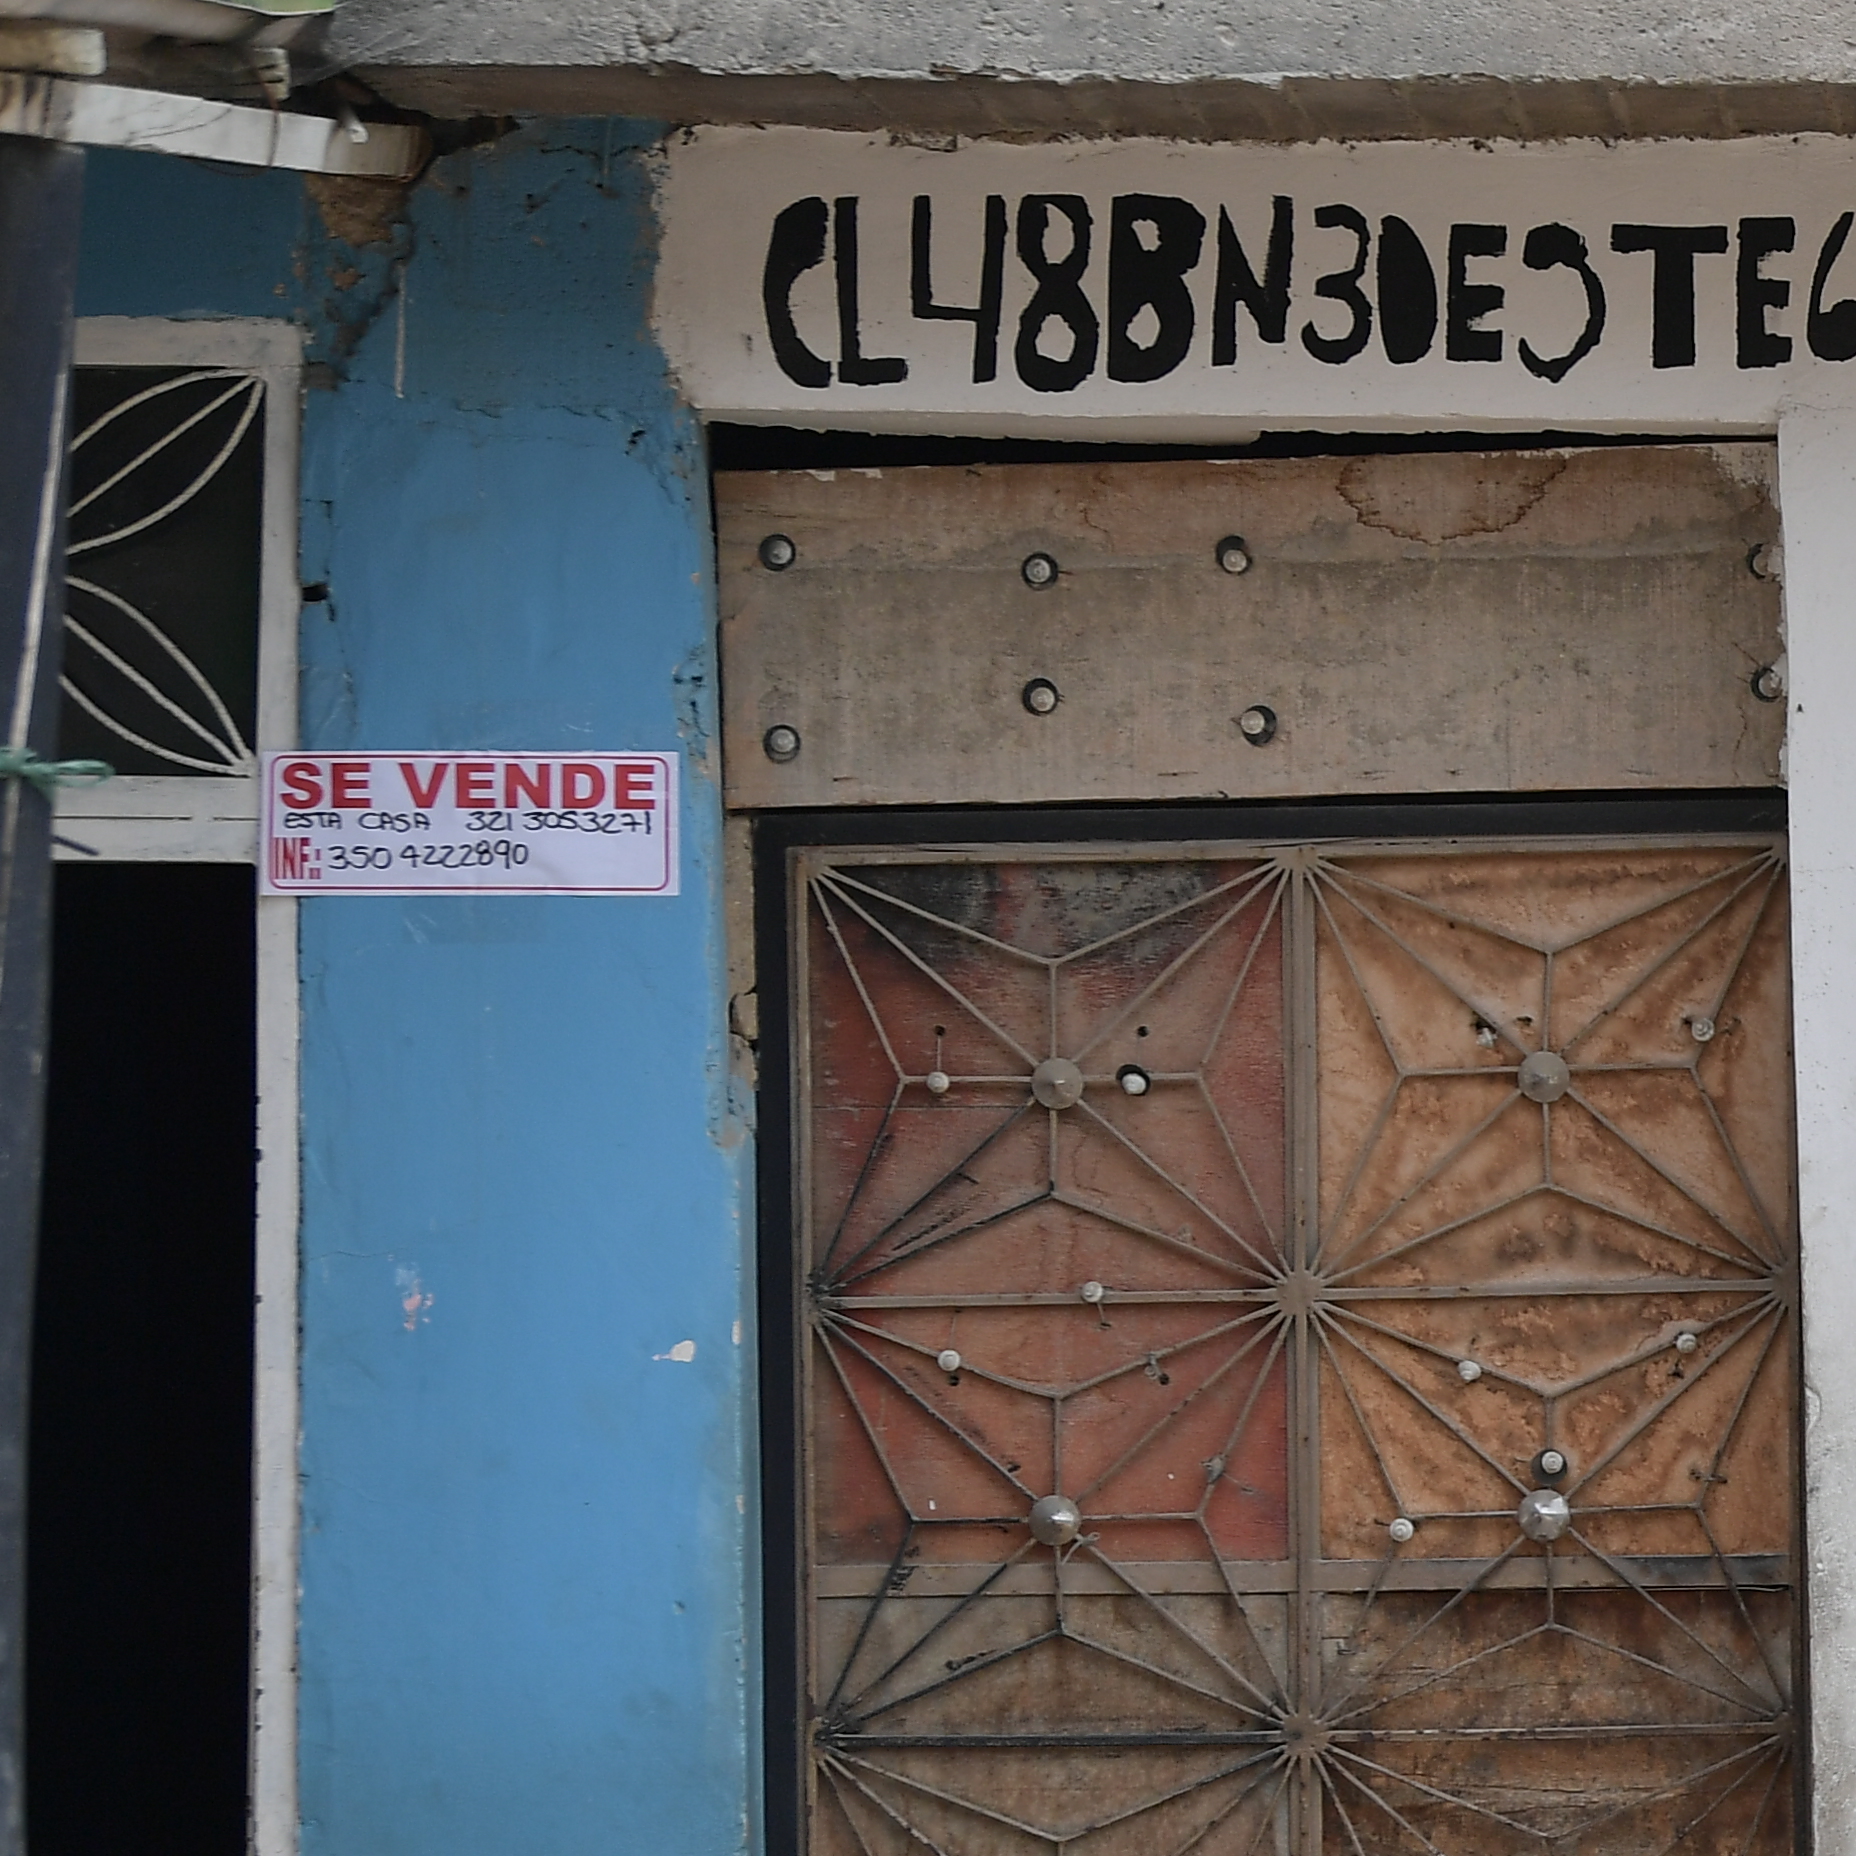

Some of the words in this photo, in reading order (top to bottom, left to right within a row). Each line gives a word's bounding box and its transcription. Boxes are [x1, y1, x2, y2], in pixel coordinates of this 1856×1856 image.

[279, 761, 372, 811] SE
[397, 762, 656, 811] VENDE
[358, 811, 432, 833] CASA
